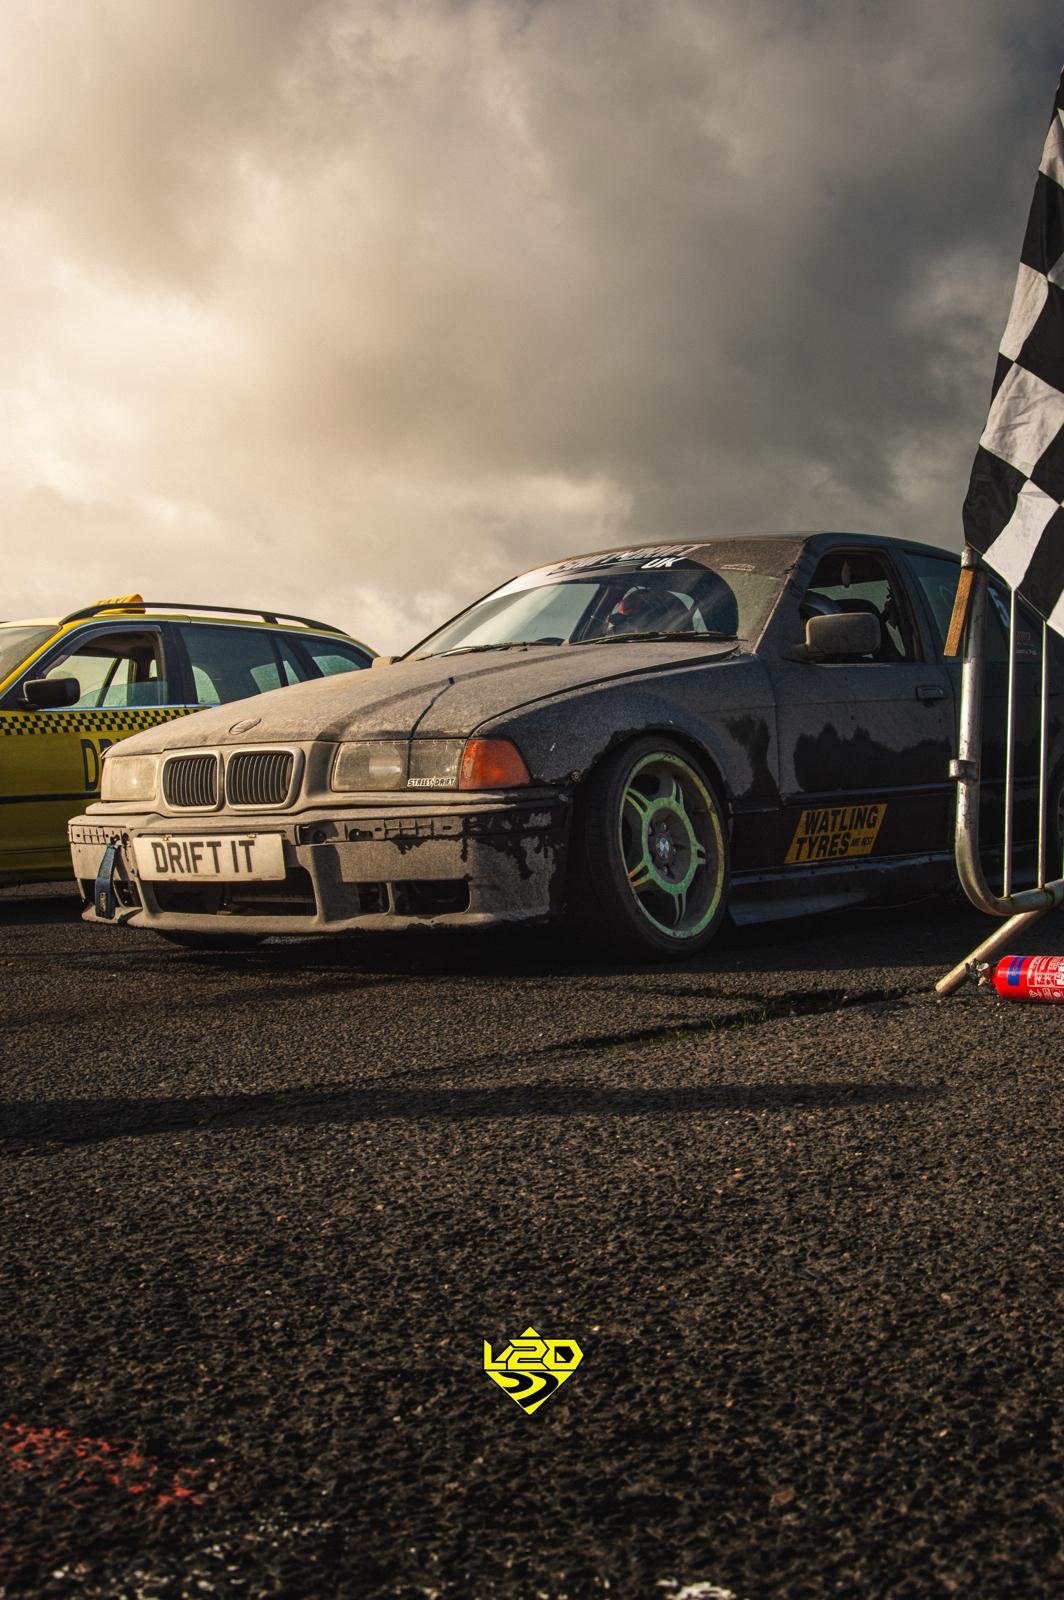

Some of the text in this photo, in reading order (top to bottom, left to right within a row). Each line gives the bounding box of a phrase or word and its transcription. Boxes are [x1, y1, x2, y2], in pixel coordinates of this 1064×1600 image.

[641, 557, 688, 569] UK
[804, 806, 878, 834] WATLING
[151, 840, 255, 874] DRIFT IT
[796, 832, 851, 860] TYRES
